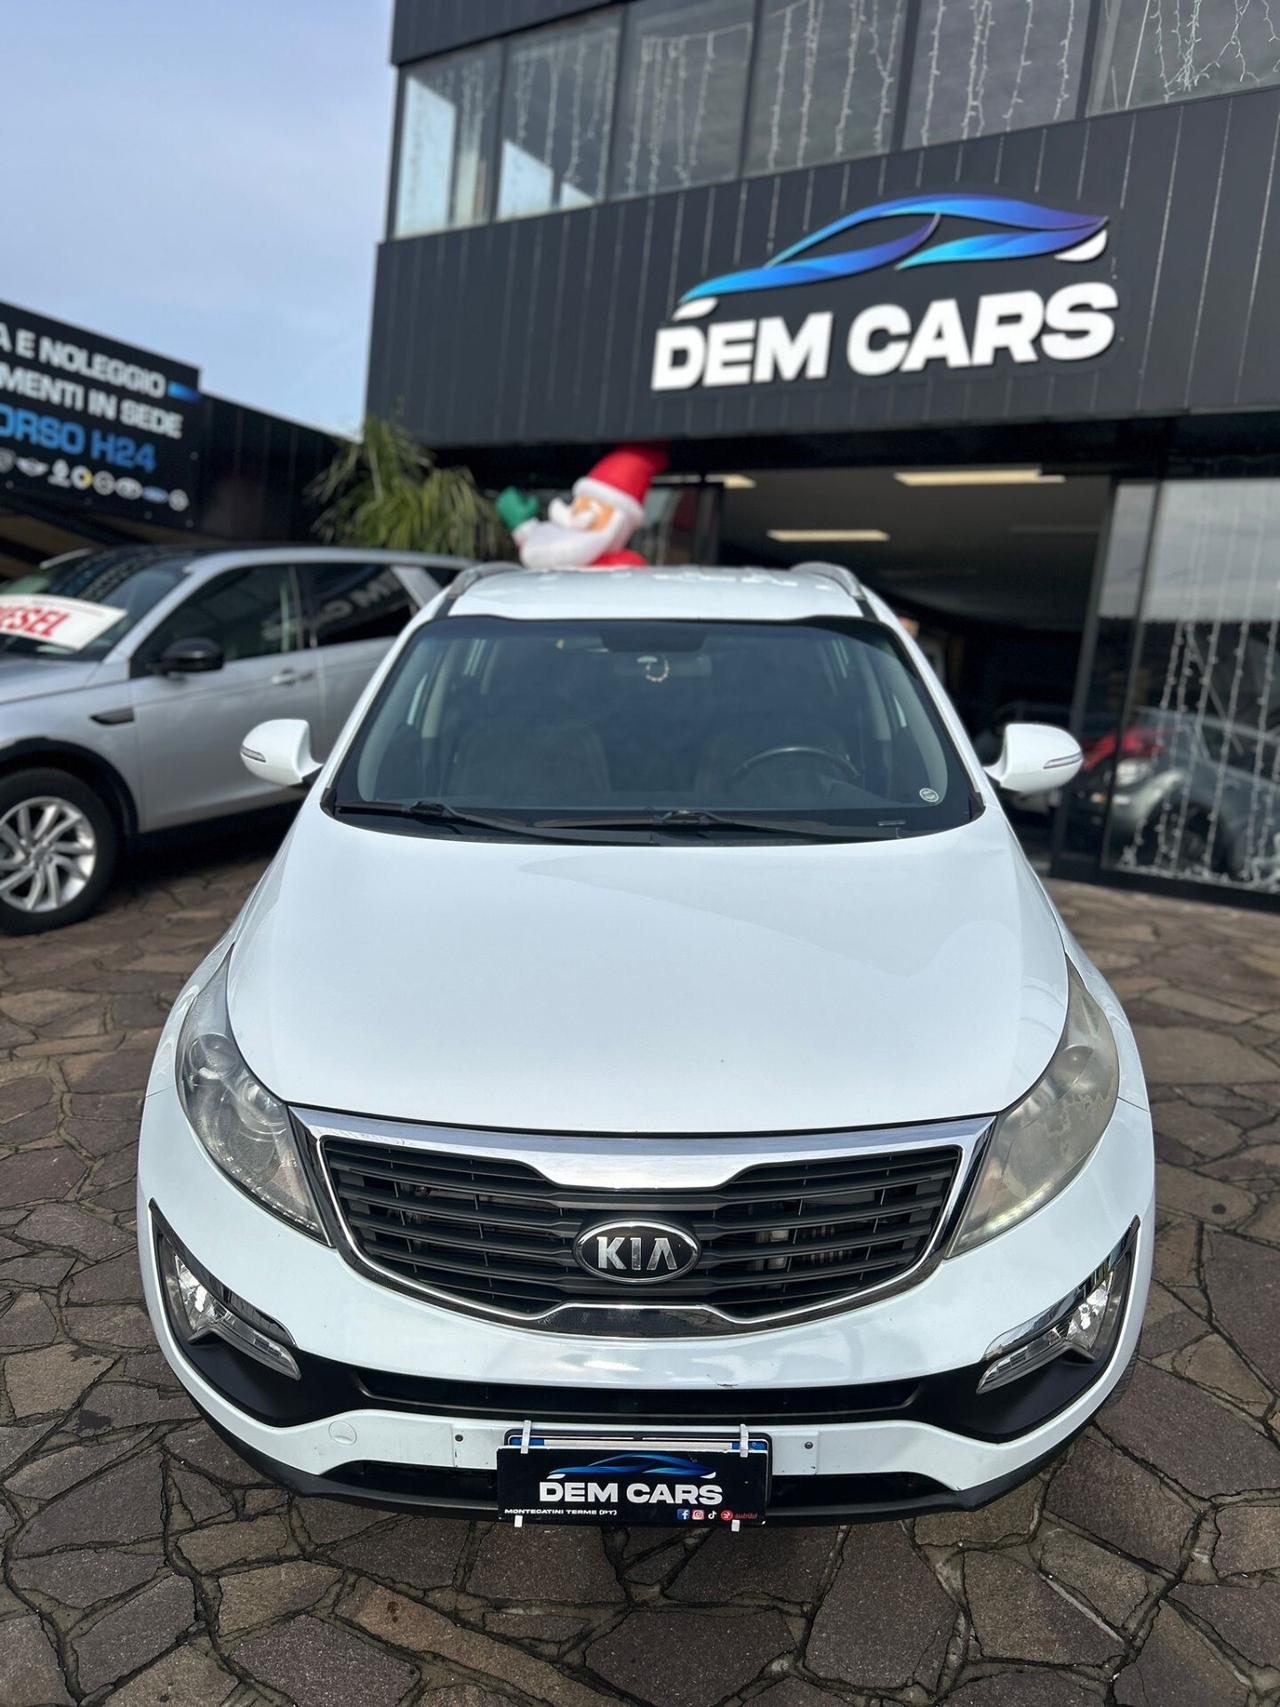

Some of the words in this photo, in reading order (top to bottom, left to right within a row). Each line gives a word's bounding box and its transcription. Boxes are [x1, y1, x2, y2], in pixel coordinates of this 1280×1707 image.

[651, 311, 833, 391] DEM
[846, 281, 1119, 376] CARS
[15, 328, 36, 359] E
[39, 336, 167, 399] NOLEGGIO
[87, 388, 118, 422] IN
[119, 399, 184, 439] SEDE
[90, 428, 157, 473] H24
[596, 1236, 678, 1271] KIA
[539, 1481, 619, 1504] DEM
[626, 1483, 723, 1506] CARS
